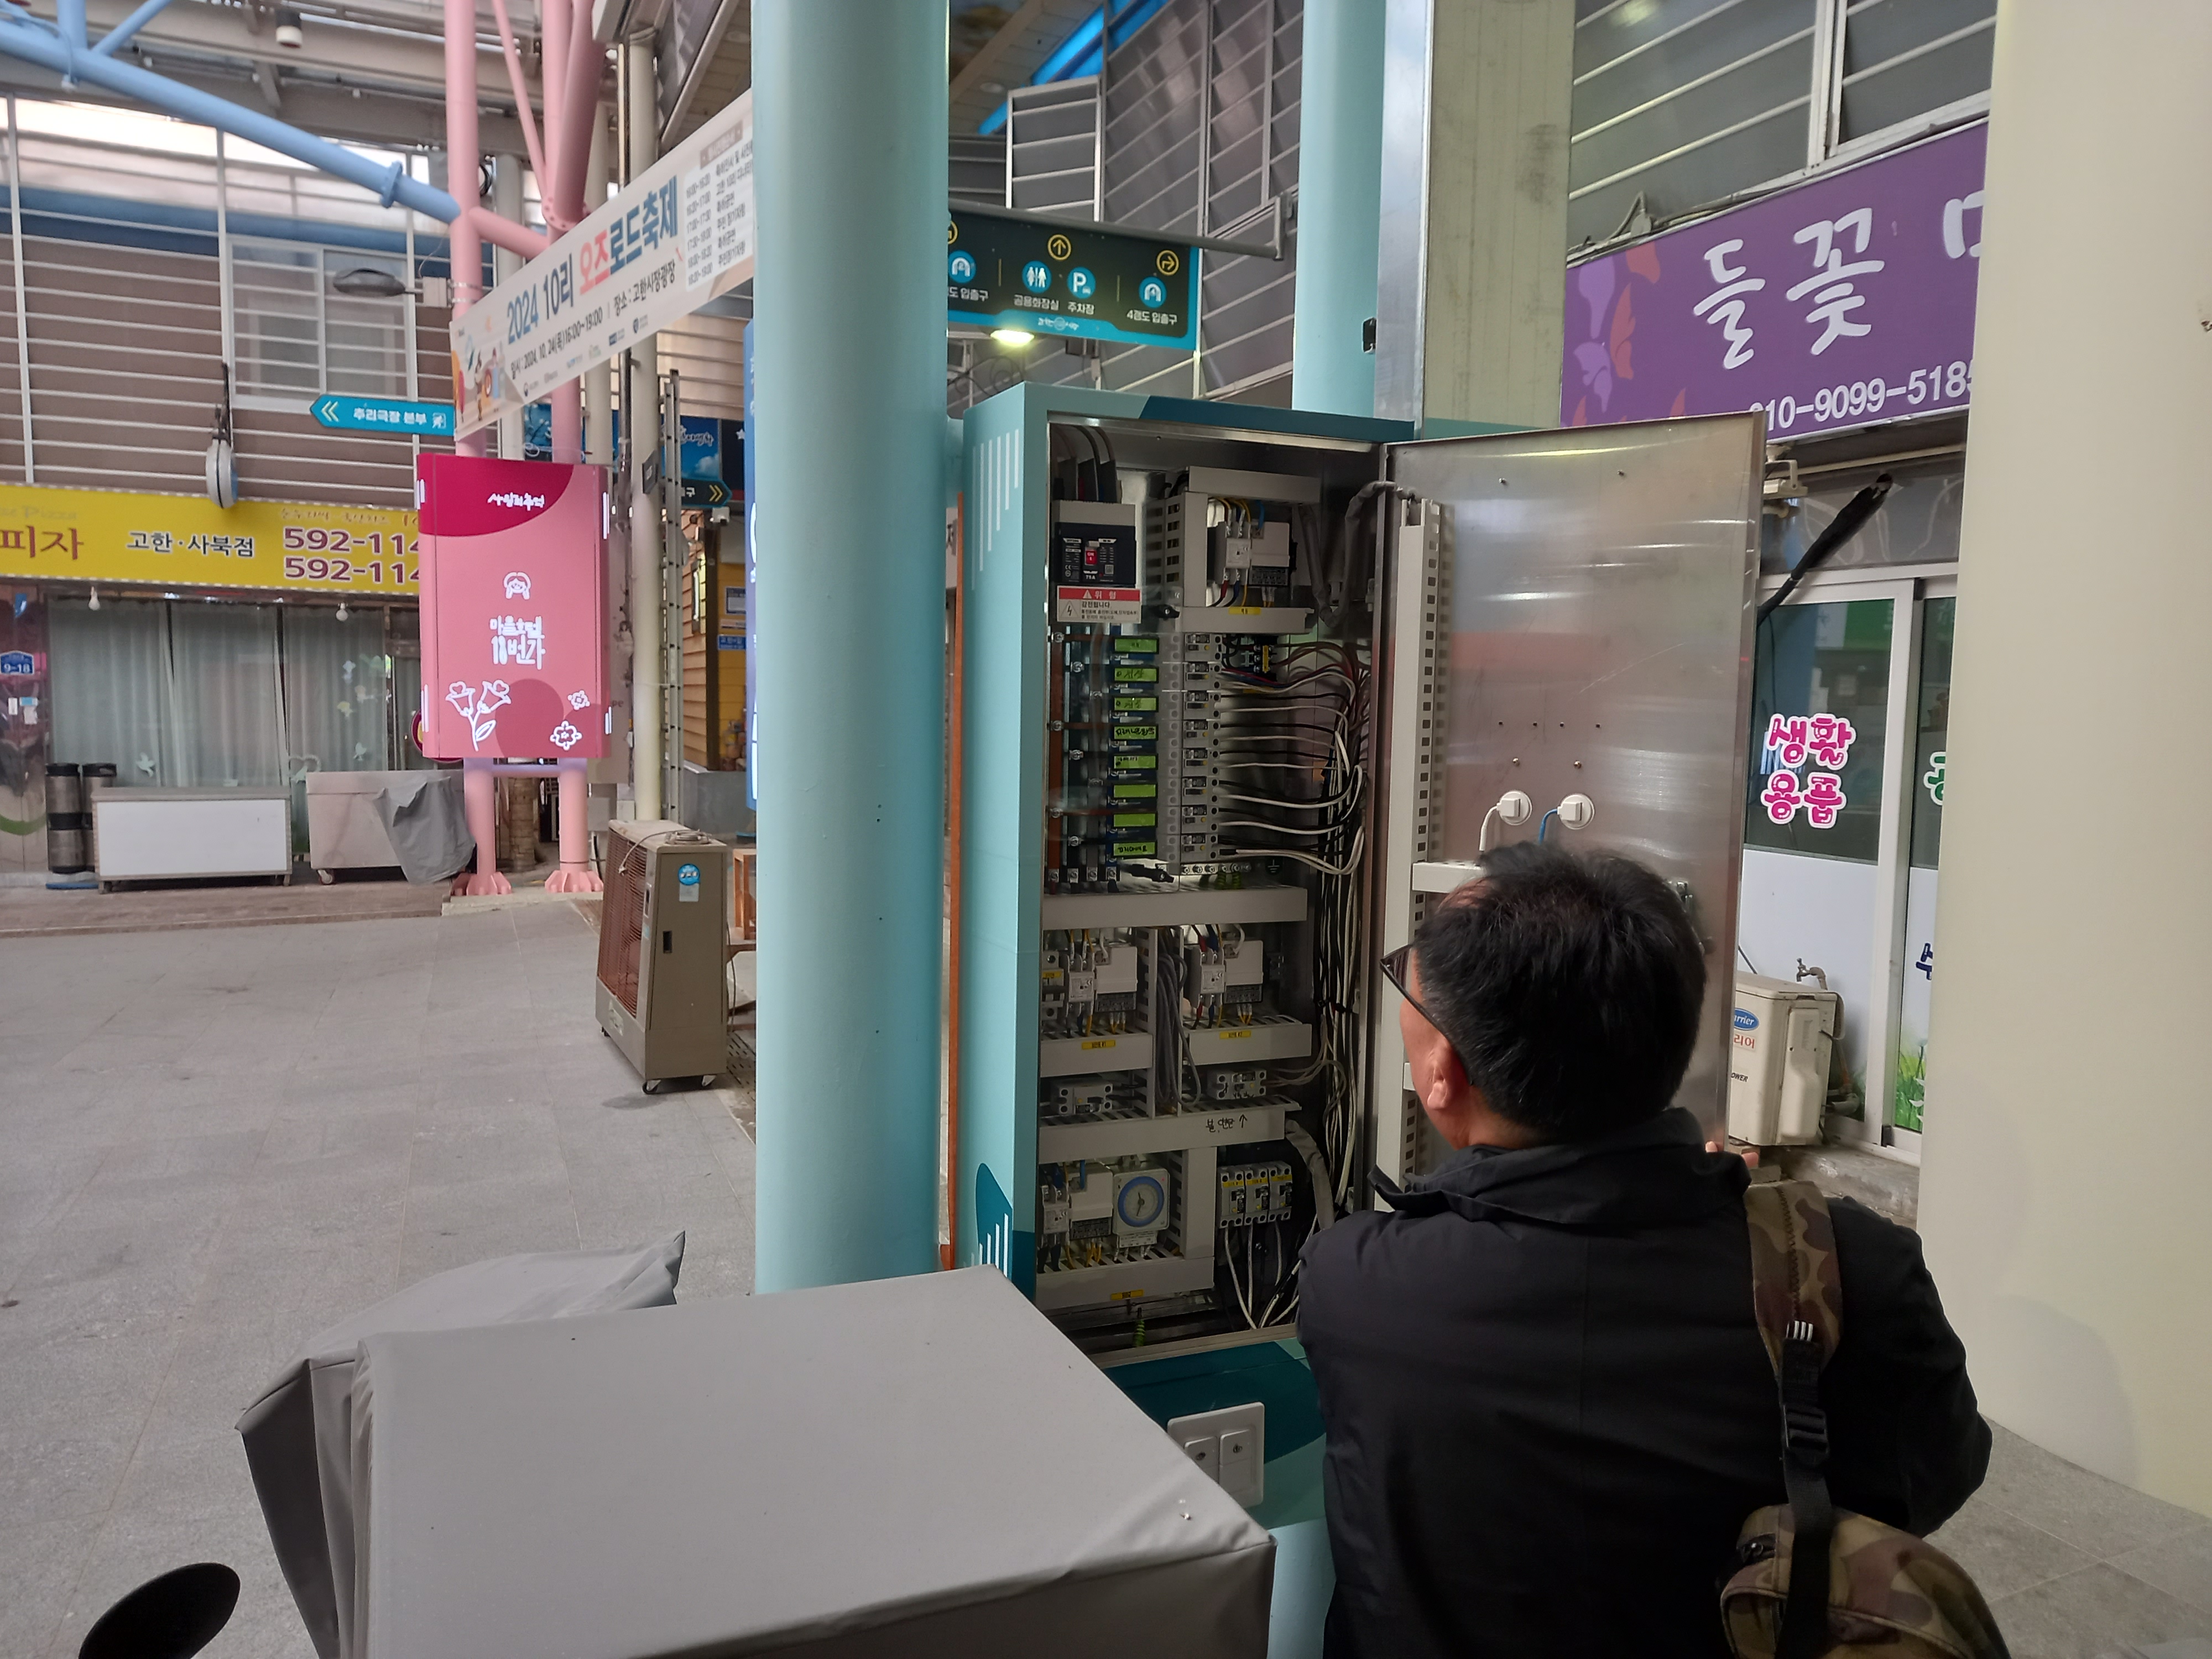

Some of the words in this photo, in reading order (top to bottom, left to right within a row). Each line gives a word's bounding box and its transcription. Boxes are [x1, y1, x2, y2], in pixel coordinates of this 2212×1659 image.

[507, 283, 539, 345] 2024
[543, 253, 574, 320] 10리
[579, 176, 678, 296] 오즈로드축제
[633, 258, 676, 302] 고한시장광장
[949, 286, 959, 298] 도
[1693, 207, 1885, 369] 들꽃
[1014, 294, 1060, 311] 공용화장실
[1067, 301, 1095, 315] 주차장
[0, 525, 84, 560] 피자
[489, 614, 546, 639] 마을호텔
[491, 634, 546, 670] 18번가
[1768, 716, 1854, 769] 생활
[1762, 772, 1845, 826] 용품
[1734, 1016, 1755, 1026] rrier
[1734, 1034, 1755, 1049] 리어
[1731, 1072, 1749, 1082] OWER
